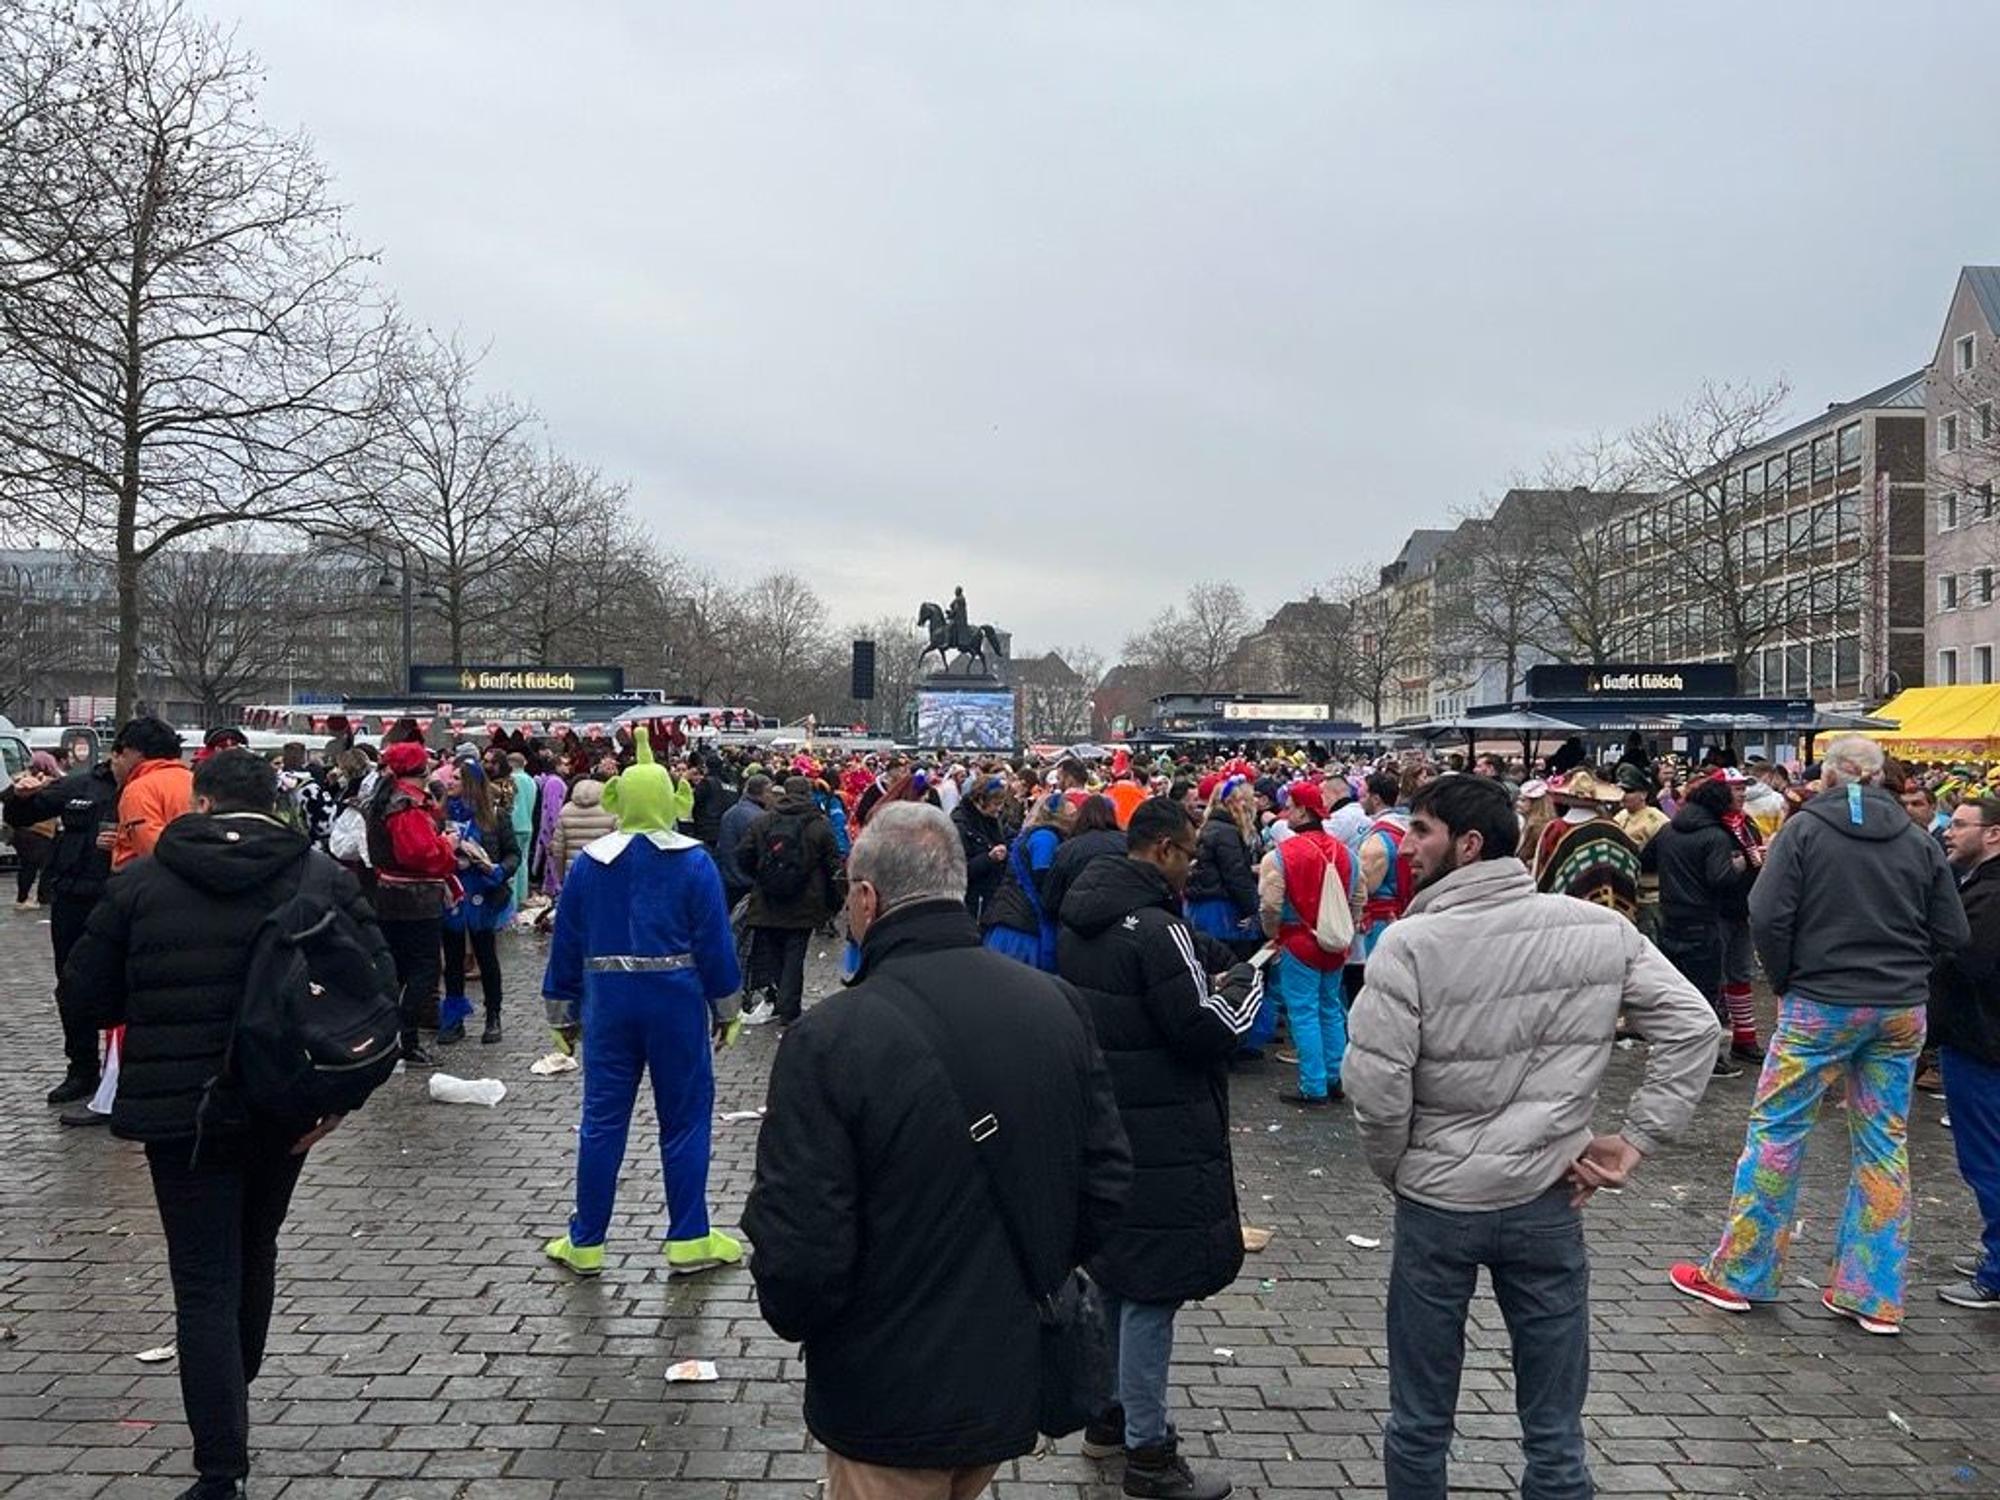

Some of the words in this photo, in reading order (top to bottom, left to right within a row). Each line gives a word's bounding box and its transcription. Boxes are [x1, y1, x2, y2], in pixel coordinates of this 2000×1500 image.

[480, 672, 523, 690] Gaffel
[525, 672, 575, 691] Kölsch
[1602, 673, 1640, 690] Gaffel
[1641, 673, 1683, 691] Kölsch
